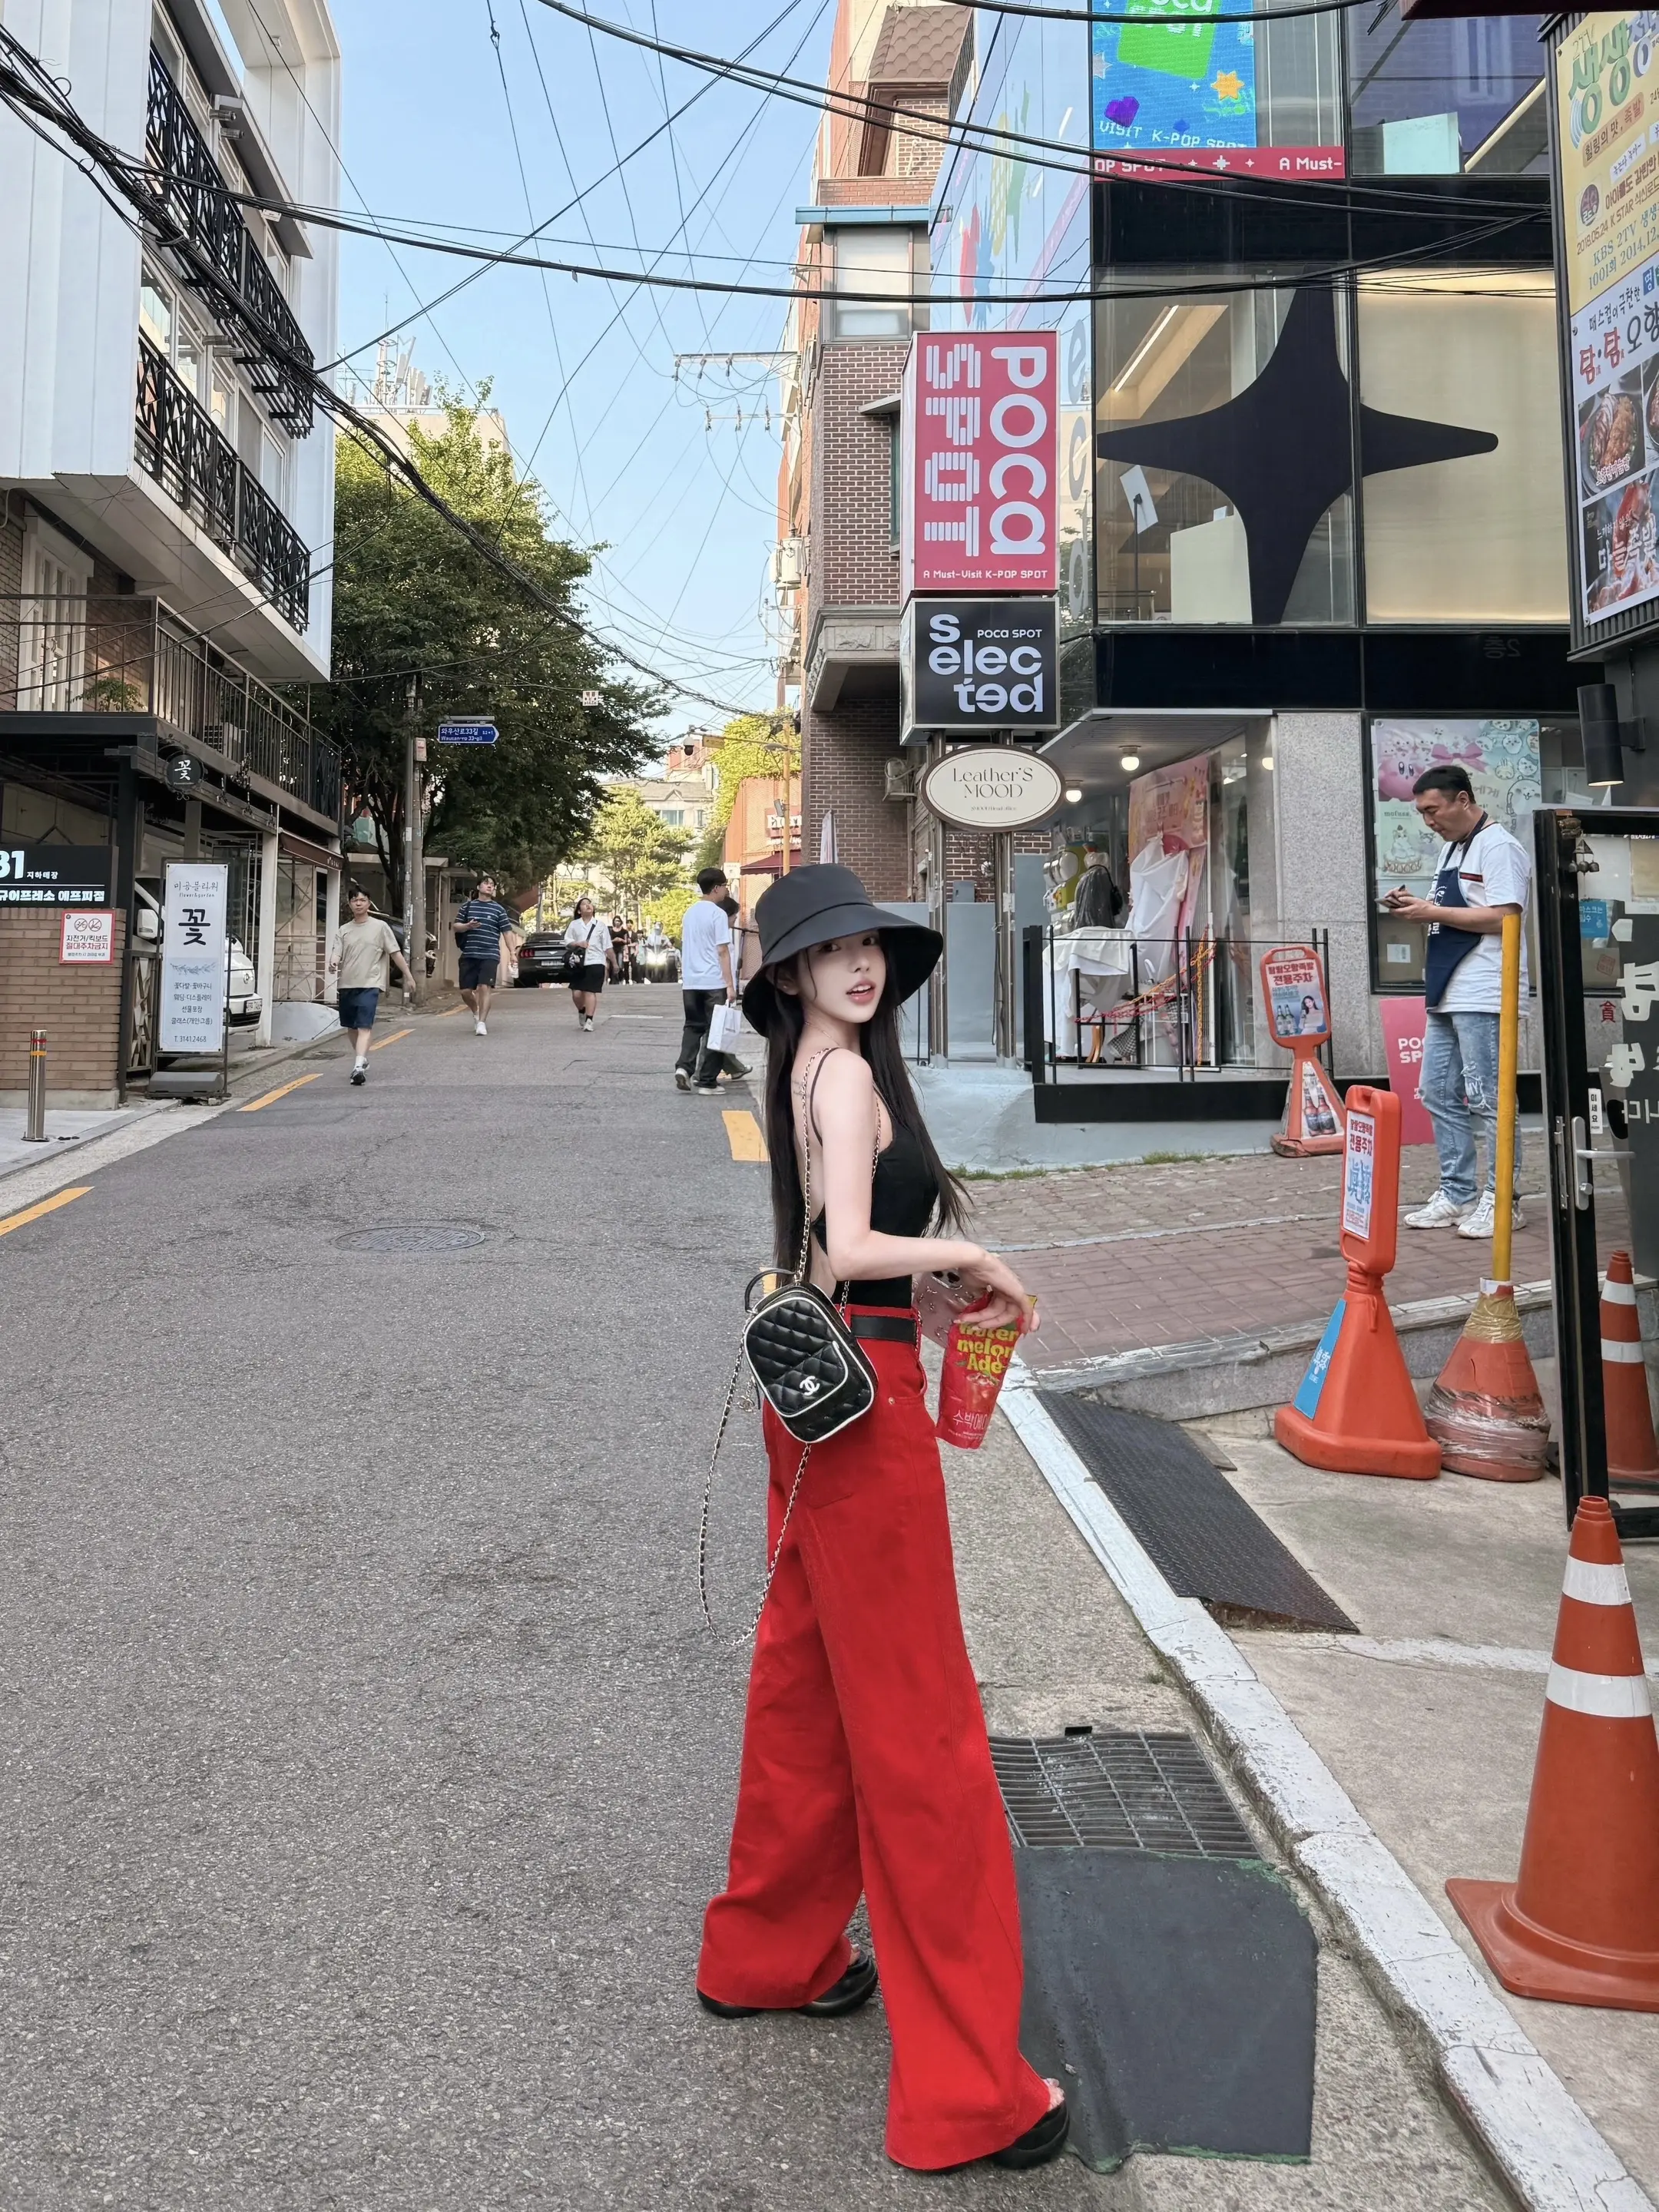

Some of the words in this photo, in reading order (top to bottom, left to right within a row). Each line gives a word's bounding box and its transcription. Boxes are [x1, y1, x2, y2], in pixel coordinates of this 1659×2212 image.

[1568, 11, 1659, 134] 생생정
[1099, 121, 1142, 139] VISIT
[1152, 129, 1200, 147] K-POP
[1585, 127, 1608, 161] 힐링의
[1624, 98, 1641, 124] 족발
[1279, 157, 1291, 171] A
[1296, 157, 1343, 171] Must-
[1616, 198, 1634, 223] STAR
[1593, 239, 1614, 267] KBS
[1617, 220, 1637, 247] 2TV
[1640, 202, 1659, 228] 생생
[1589, 257, 1617, 290] 1001회
[924, 343, 982, 557] SPOT
[923, 570, 930, 579] A
[933, 570, 982, 579] Must-Visit
[985, 571, 1018, 579] K-POP
[1020, 570, 1048, 579] SPOT
[1012, 629, 1042, 638] SPOT
[174, 760, 192, 781] 꽃
[964, 783, 1023, 798] MOOD
[27, 871, 58, 879] 지하매장
[58, 890, 105, 902] 에프피점
[178, 909, 211, 946] 꽃
[1273, 972, 1313, 986] 전용주차
[967, 1353, 1003, 1374] Ade
